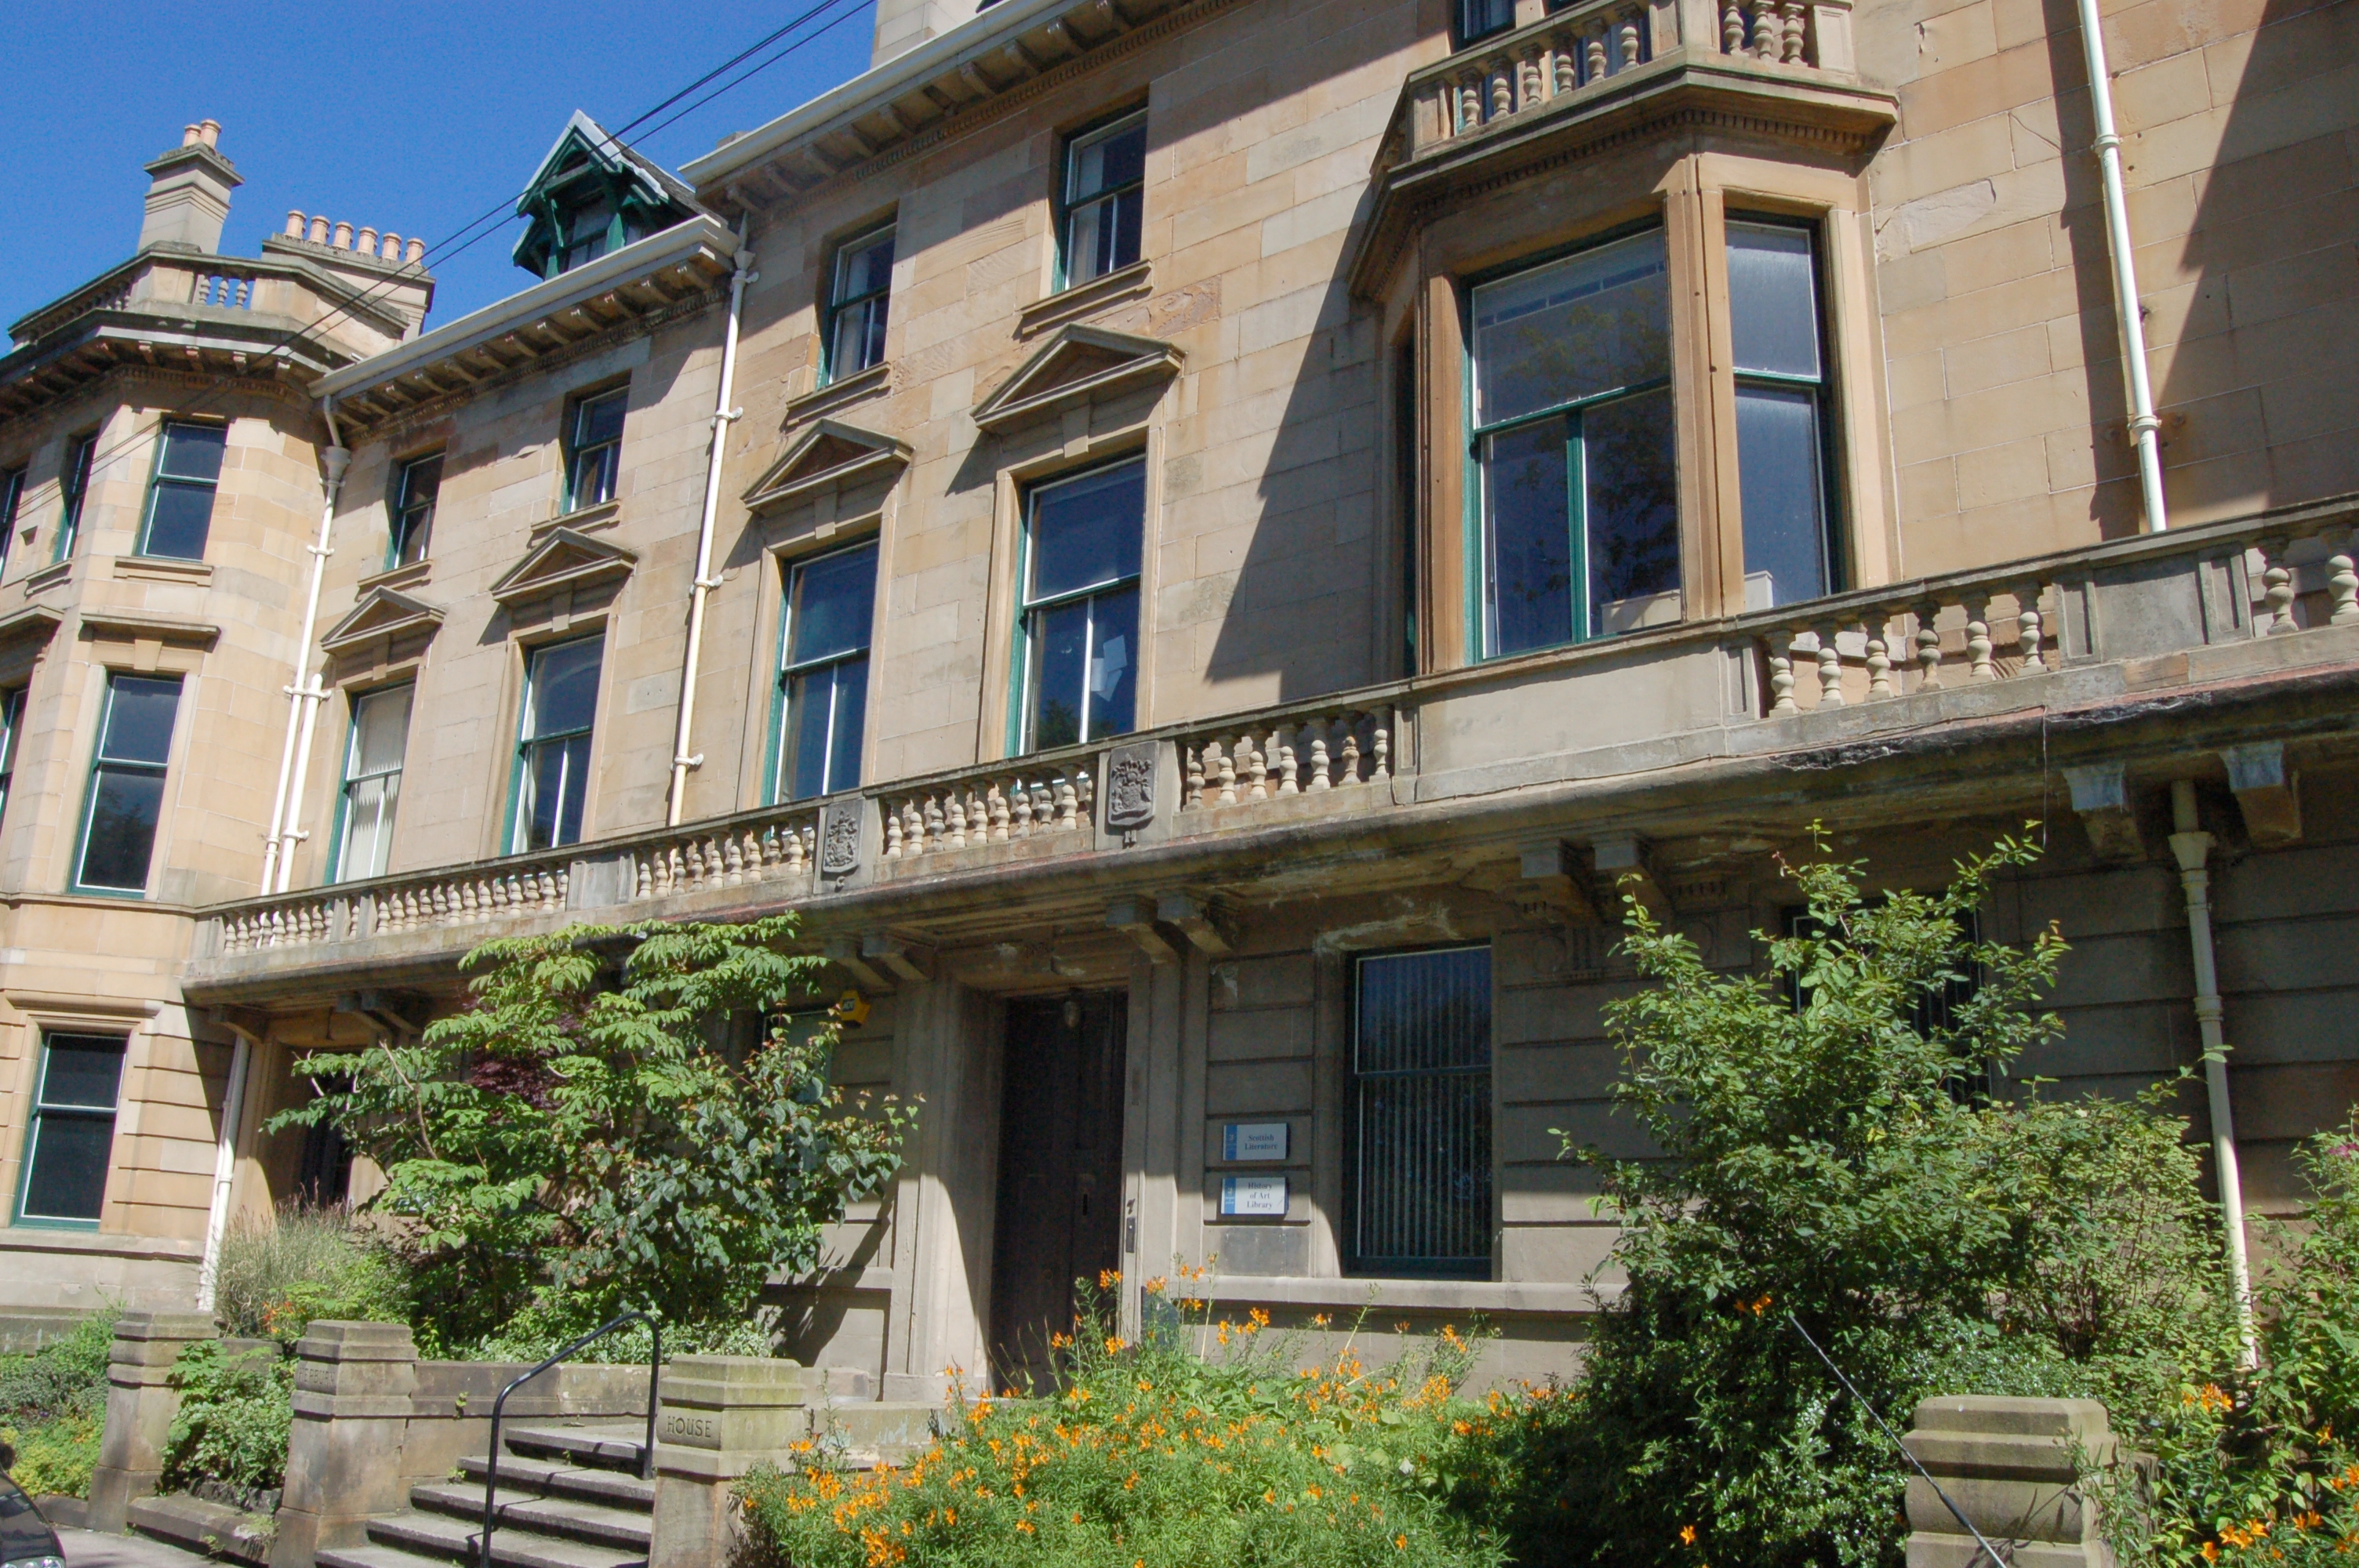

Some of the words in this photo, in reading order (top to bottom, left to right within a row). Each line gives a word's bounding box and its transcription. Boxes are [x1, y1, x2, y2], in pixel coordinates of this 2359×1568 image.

[1248, 1182, 1272, 1191] History
[1247, 1201, 1272, 1210] Library
[667, 1415, 712, 1438] HOUSE
